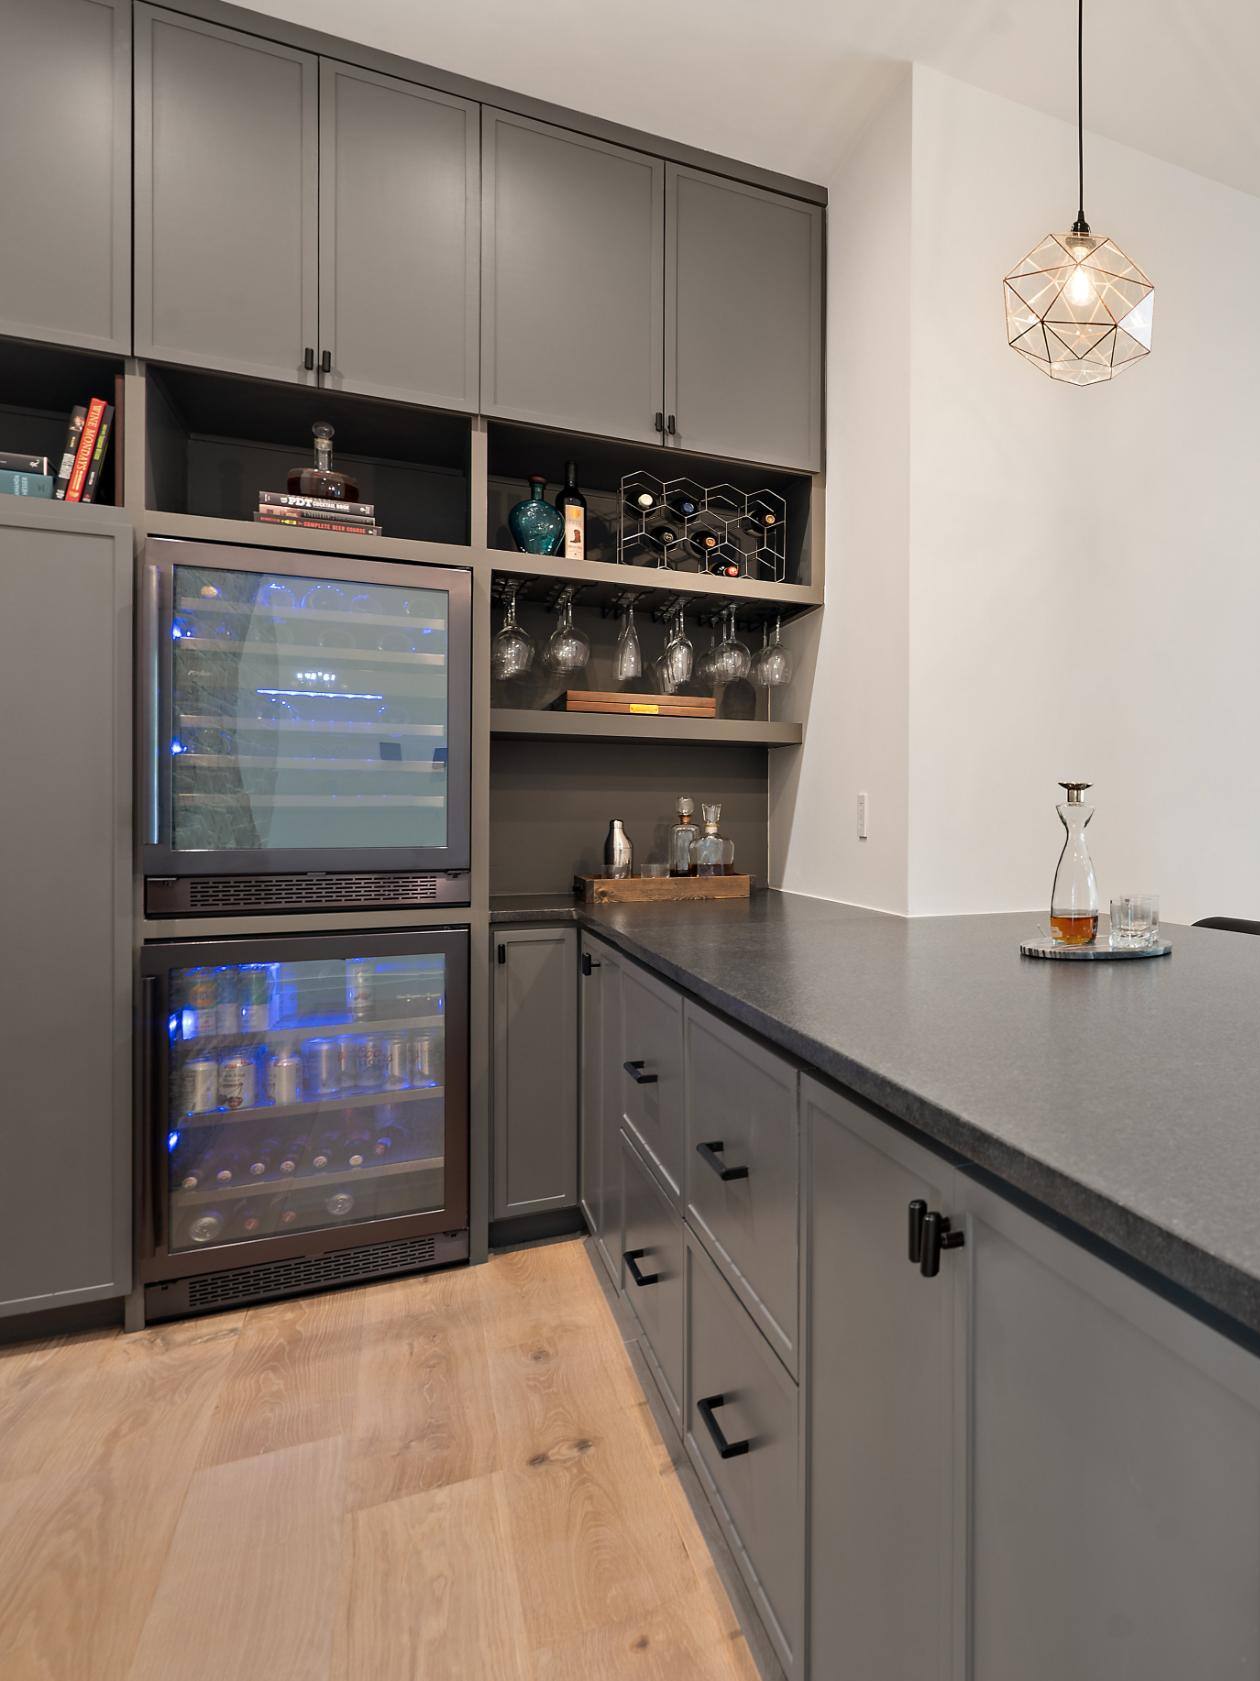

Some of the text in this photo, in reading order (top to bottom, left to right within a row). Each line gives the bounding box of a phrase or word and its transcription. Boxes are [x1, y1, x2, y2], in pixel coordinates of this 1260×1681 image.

[88, 405, 103, 428] WINE
[76, 428, 97, 472] MONDAYS
[288, 497, 313, 508] PDT
